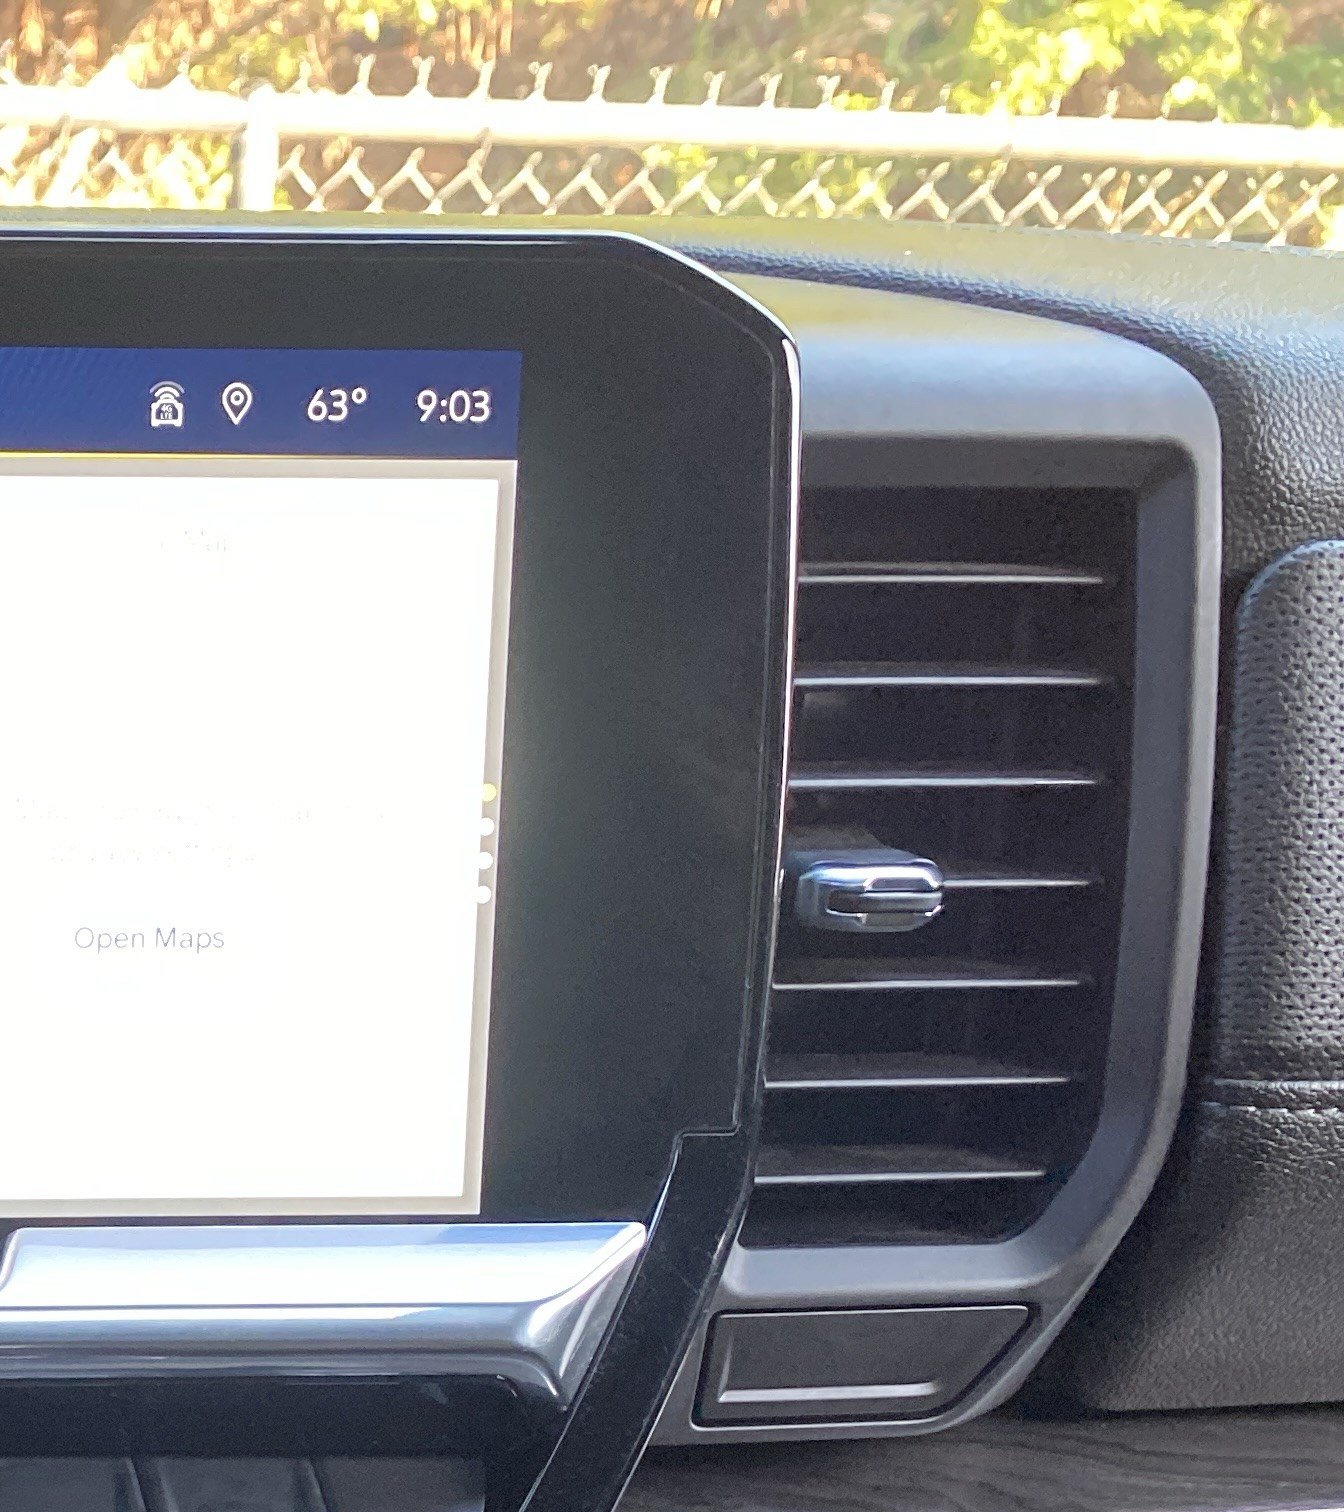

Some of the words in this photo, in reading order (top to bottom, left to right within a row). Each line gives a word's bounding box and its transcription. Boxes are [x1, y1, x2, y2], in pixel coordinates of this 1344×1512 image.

[307, 387, 367, 422] 63°
[417, 389, 490, 423] 9:03
[74, 926, 145, 955] Open
[155, 926, 225, 955] Maps
